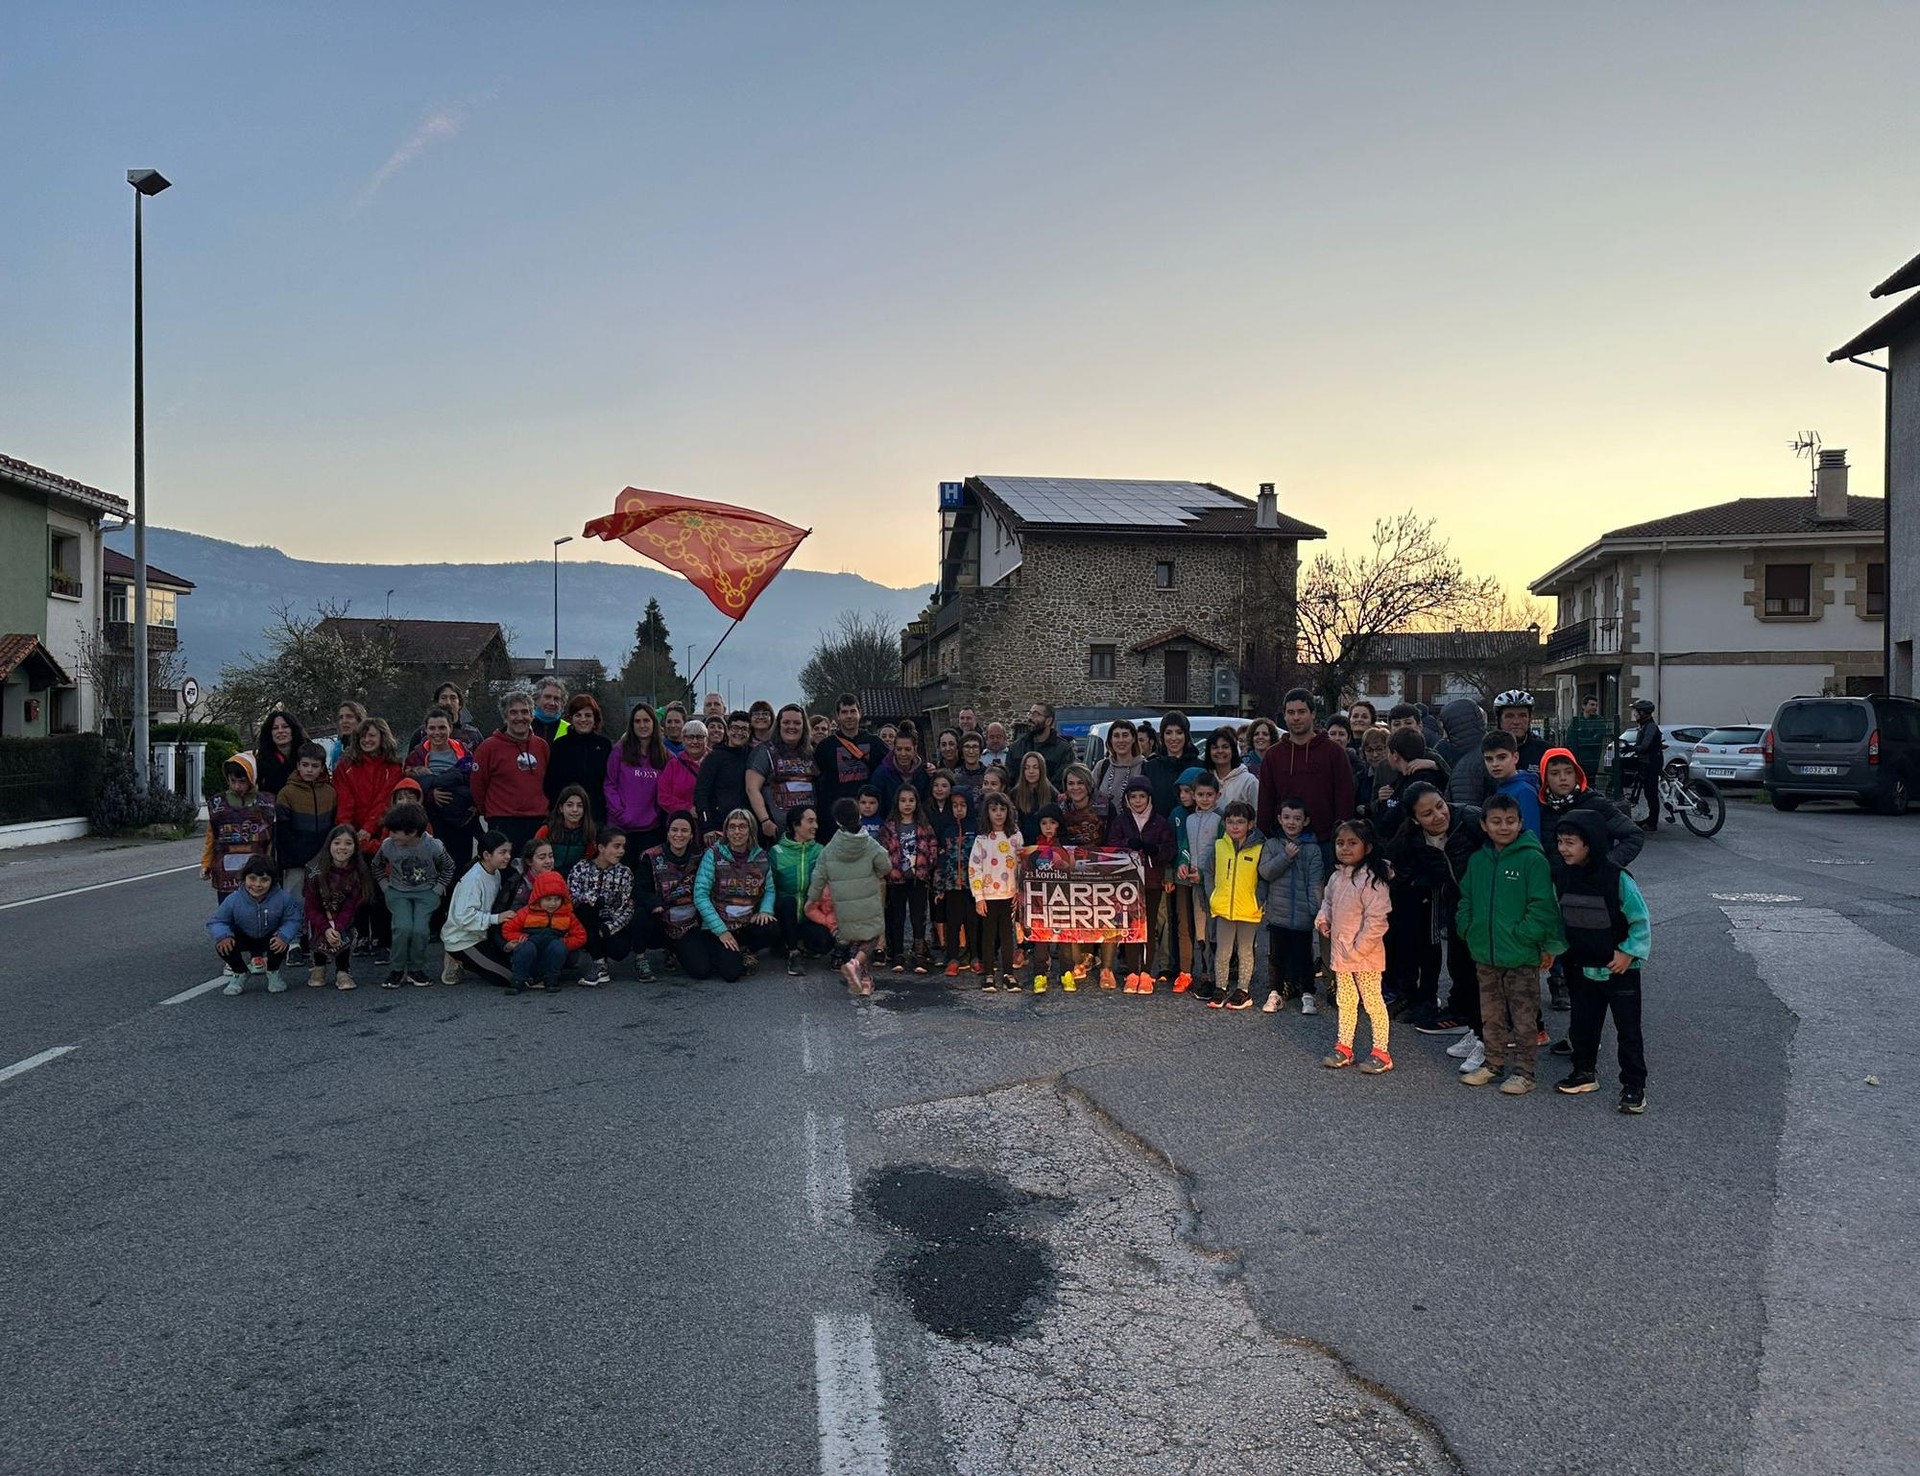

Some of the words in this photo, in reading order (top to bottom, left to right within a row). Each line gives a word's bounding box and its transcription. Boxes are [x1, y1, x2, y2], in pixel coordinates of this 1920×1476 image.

[945, 484, 958, 500] H
[634, 769, 659, 778] ROXY
[1026, 881, 1138, 906] HARRO
